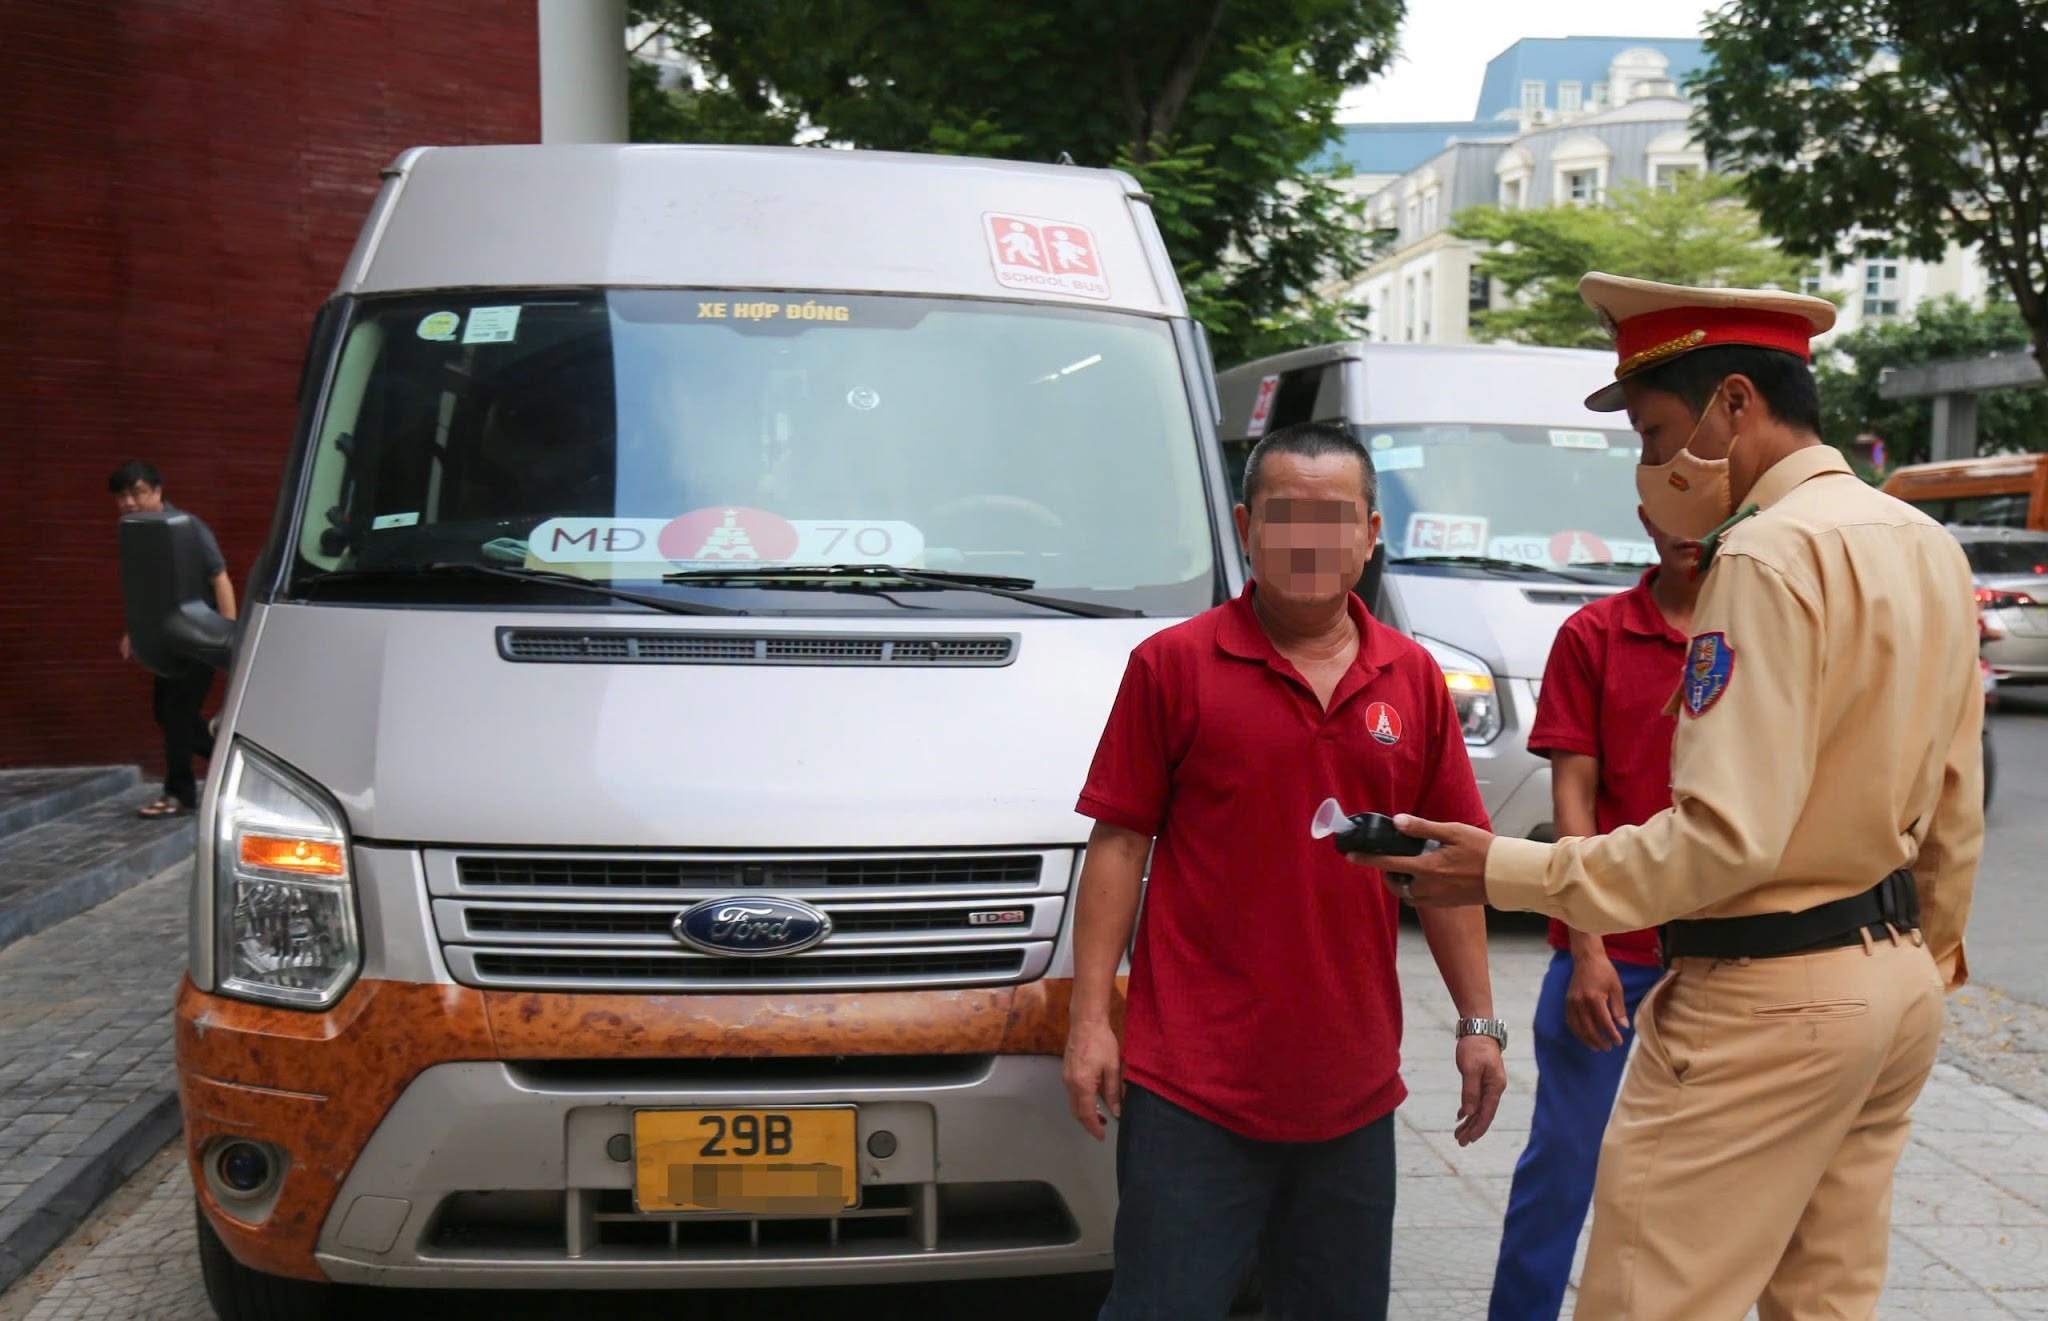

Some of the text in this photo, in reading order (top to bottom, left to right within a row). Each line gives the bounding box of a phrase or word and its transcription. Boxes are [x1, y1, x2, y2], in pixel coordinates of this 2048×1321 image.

[1001, 271, 1105, 293] SCHOOL BUS
[697, 302, 727, 318] XE
[734, 302, 780, 321] HỢP
[551, 527, 893, 557] MĐ 70
[710, 907, 793, 942] Ford
[699, 1115, 792, 1157] 29B
